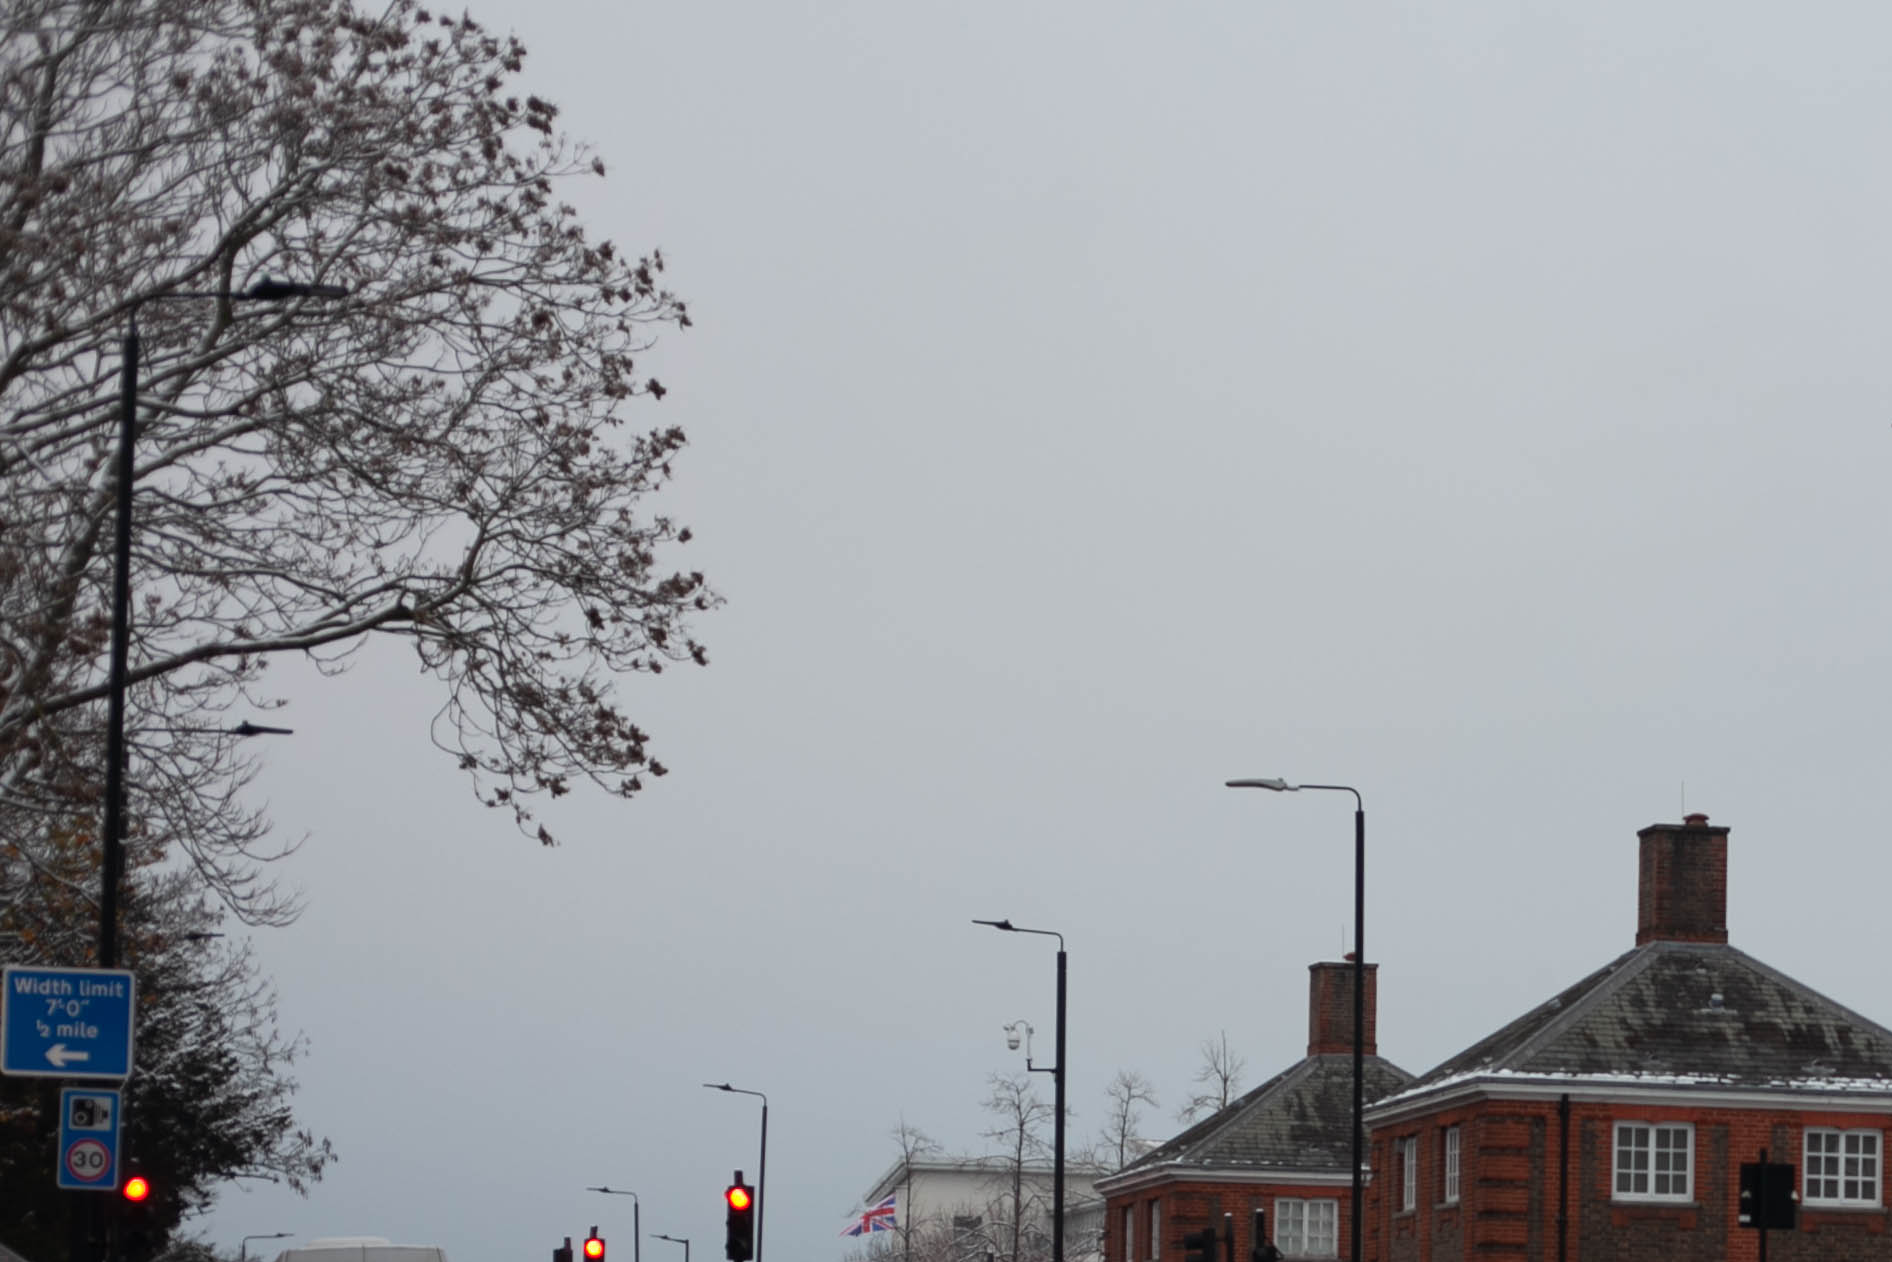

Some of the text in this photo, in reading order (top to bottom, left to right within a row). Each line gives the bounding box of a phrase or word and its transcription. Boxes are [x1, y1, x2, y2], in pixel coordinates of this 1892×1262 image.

[14, 976, 125, 998] Width limit
[56, 1020, 99, 1038] mile
[72, 1150, 104, 1169] 30
